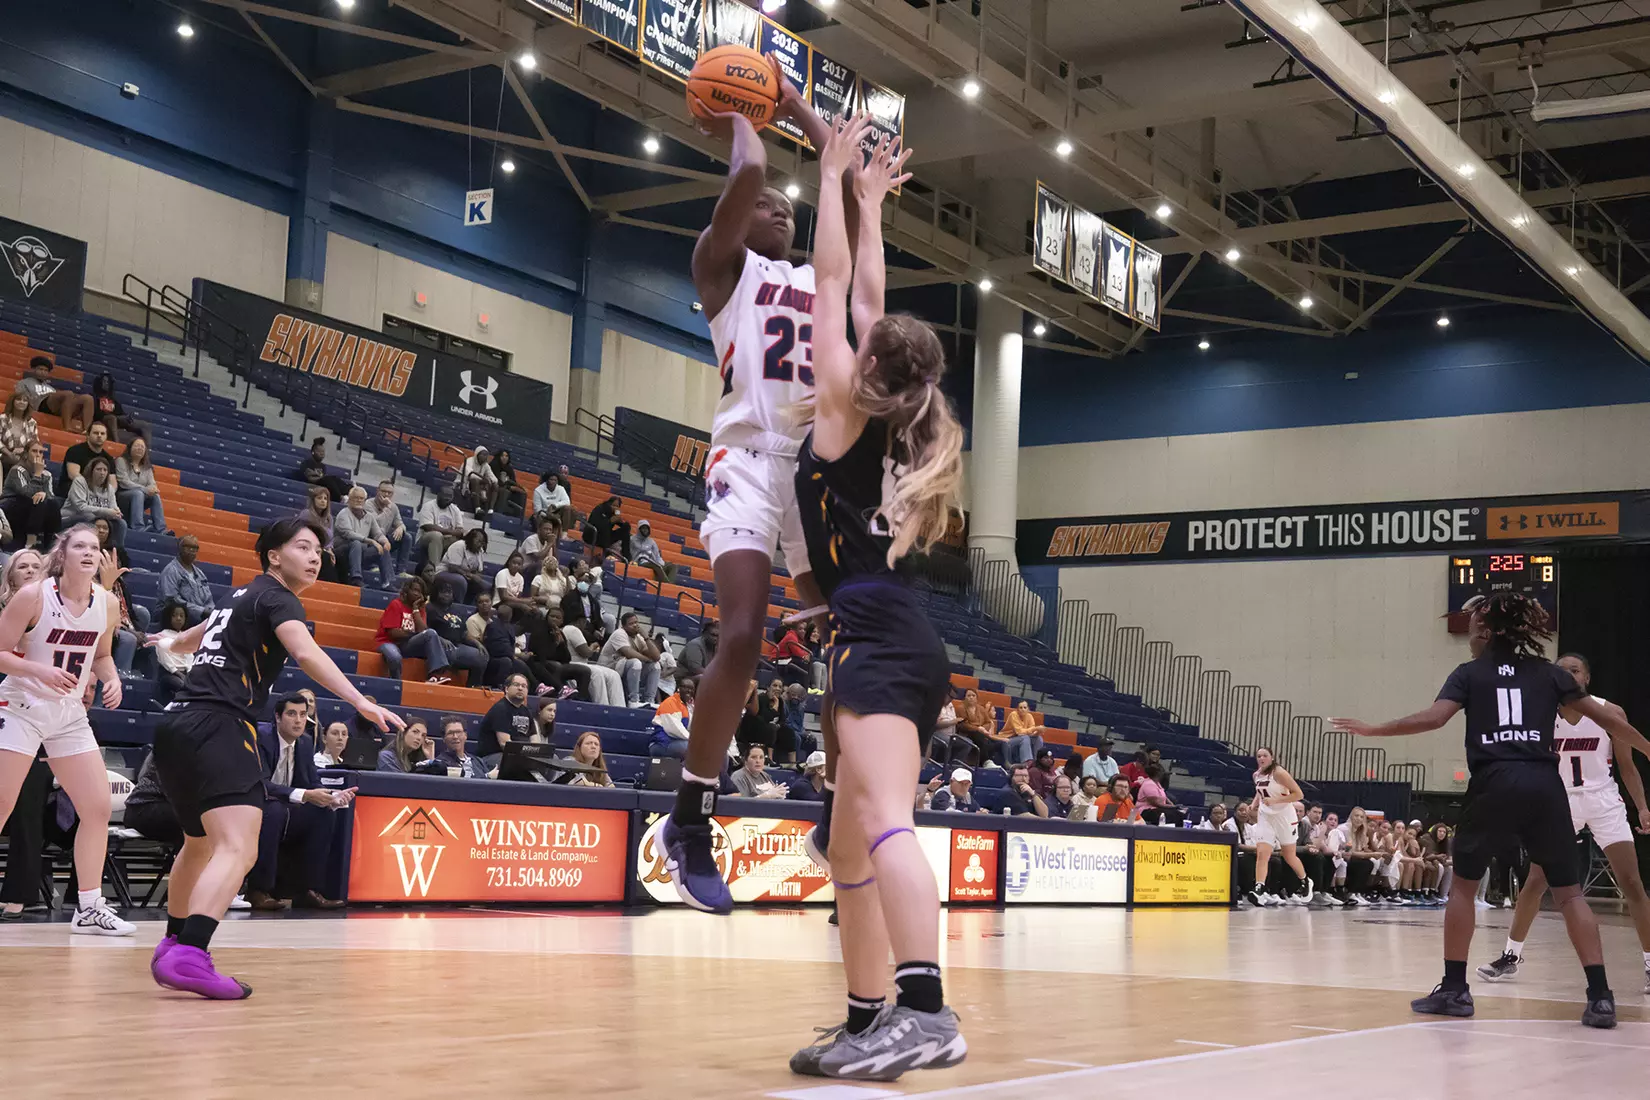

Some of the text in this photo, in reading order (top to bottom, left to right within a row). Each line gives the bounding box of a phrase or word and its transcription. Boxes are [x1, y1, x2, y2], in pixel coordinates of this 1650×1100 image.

[771, 29, 799, 55] 2016
[656, 53, 675, 68] FIRST
[675, 62, 691, 77] ROUN
[822, 58, 848, 81] 2017
[726, 64, 768, 87] NCAA
[824, 78, 844, 93] MEN'S
[711, 87, 767, 119] Wilson
[468, 192, 491, 201] SECTION
[469, 200, 487, 222] K
[1046, 236, 1058, 256] 23
[1079, 256, 1091, 274] 43
[1112, 274, 1123, 292] 13
[755, 282, 781, 306] UT
[259, 313, 418, 397] SKYHAWKS
[450, 405, 503, 425] UNDER ARMOUR
[1535, 514, 1545, 529] I
[1046, 521, 1171, 557] SKYHAWKS
[1188, 515, 1309, 552] PROTECT
[1314, 512, 1365, 547] THIS
[1490, 555, 1524, 571] 2:25
[1530, 555, 1553, 564] Guests
[1460, 568, 1474, 584] 11
[1542, 565, 1553, 582] 8
[1491, 581, 1512, 591] period
[45, 628, 66, 644] UT
[1496, 687, 1523, 727] 11
[1481, 730, 1541, 744] LIONS
[1562, 737, 1600, 752] MARTIN
[1570, 756, 1584, 787] 1
[109, 781, 131, 795] WKS
[470, 818, 601, 849] WINSTEAD
[742, 824, 810, 857] Furnit
[470, 848, 489, 860] Real
[492, 849, 519, 861] Estate
[520, 849, 527, 861] &
[528, 849, 549, 861] Land
[551, 850, 589, 864] Company
[1033, 844, 1127, 872] West Tennessee
[389, 843, 447, 897] W
[486, 866, 582, 888] 731.504.8969
[736, 859, 748, 877] &
[769, 881, 802, 897] MARTIN
[1035, 875, 1095, 890] HEALTHCARE
[955, 887, 966, 895] Scott
[981, 888, 994, 897] Agent
